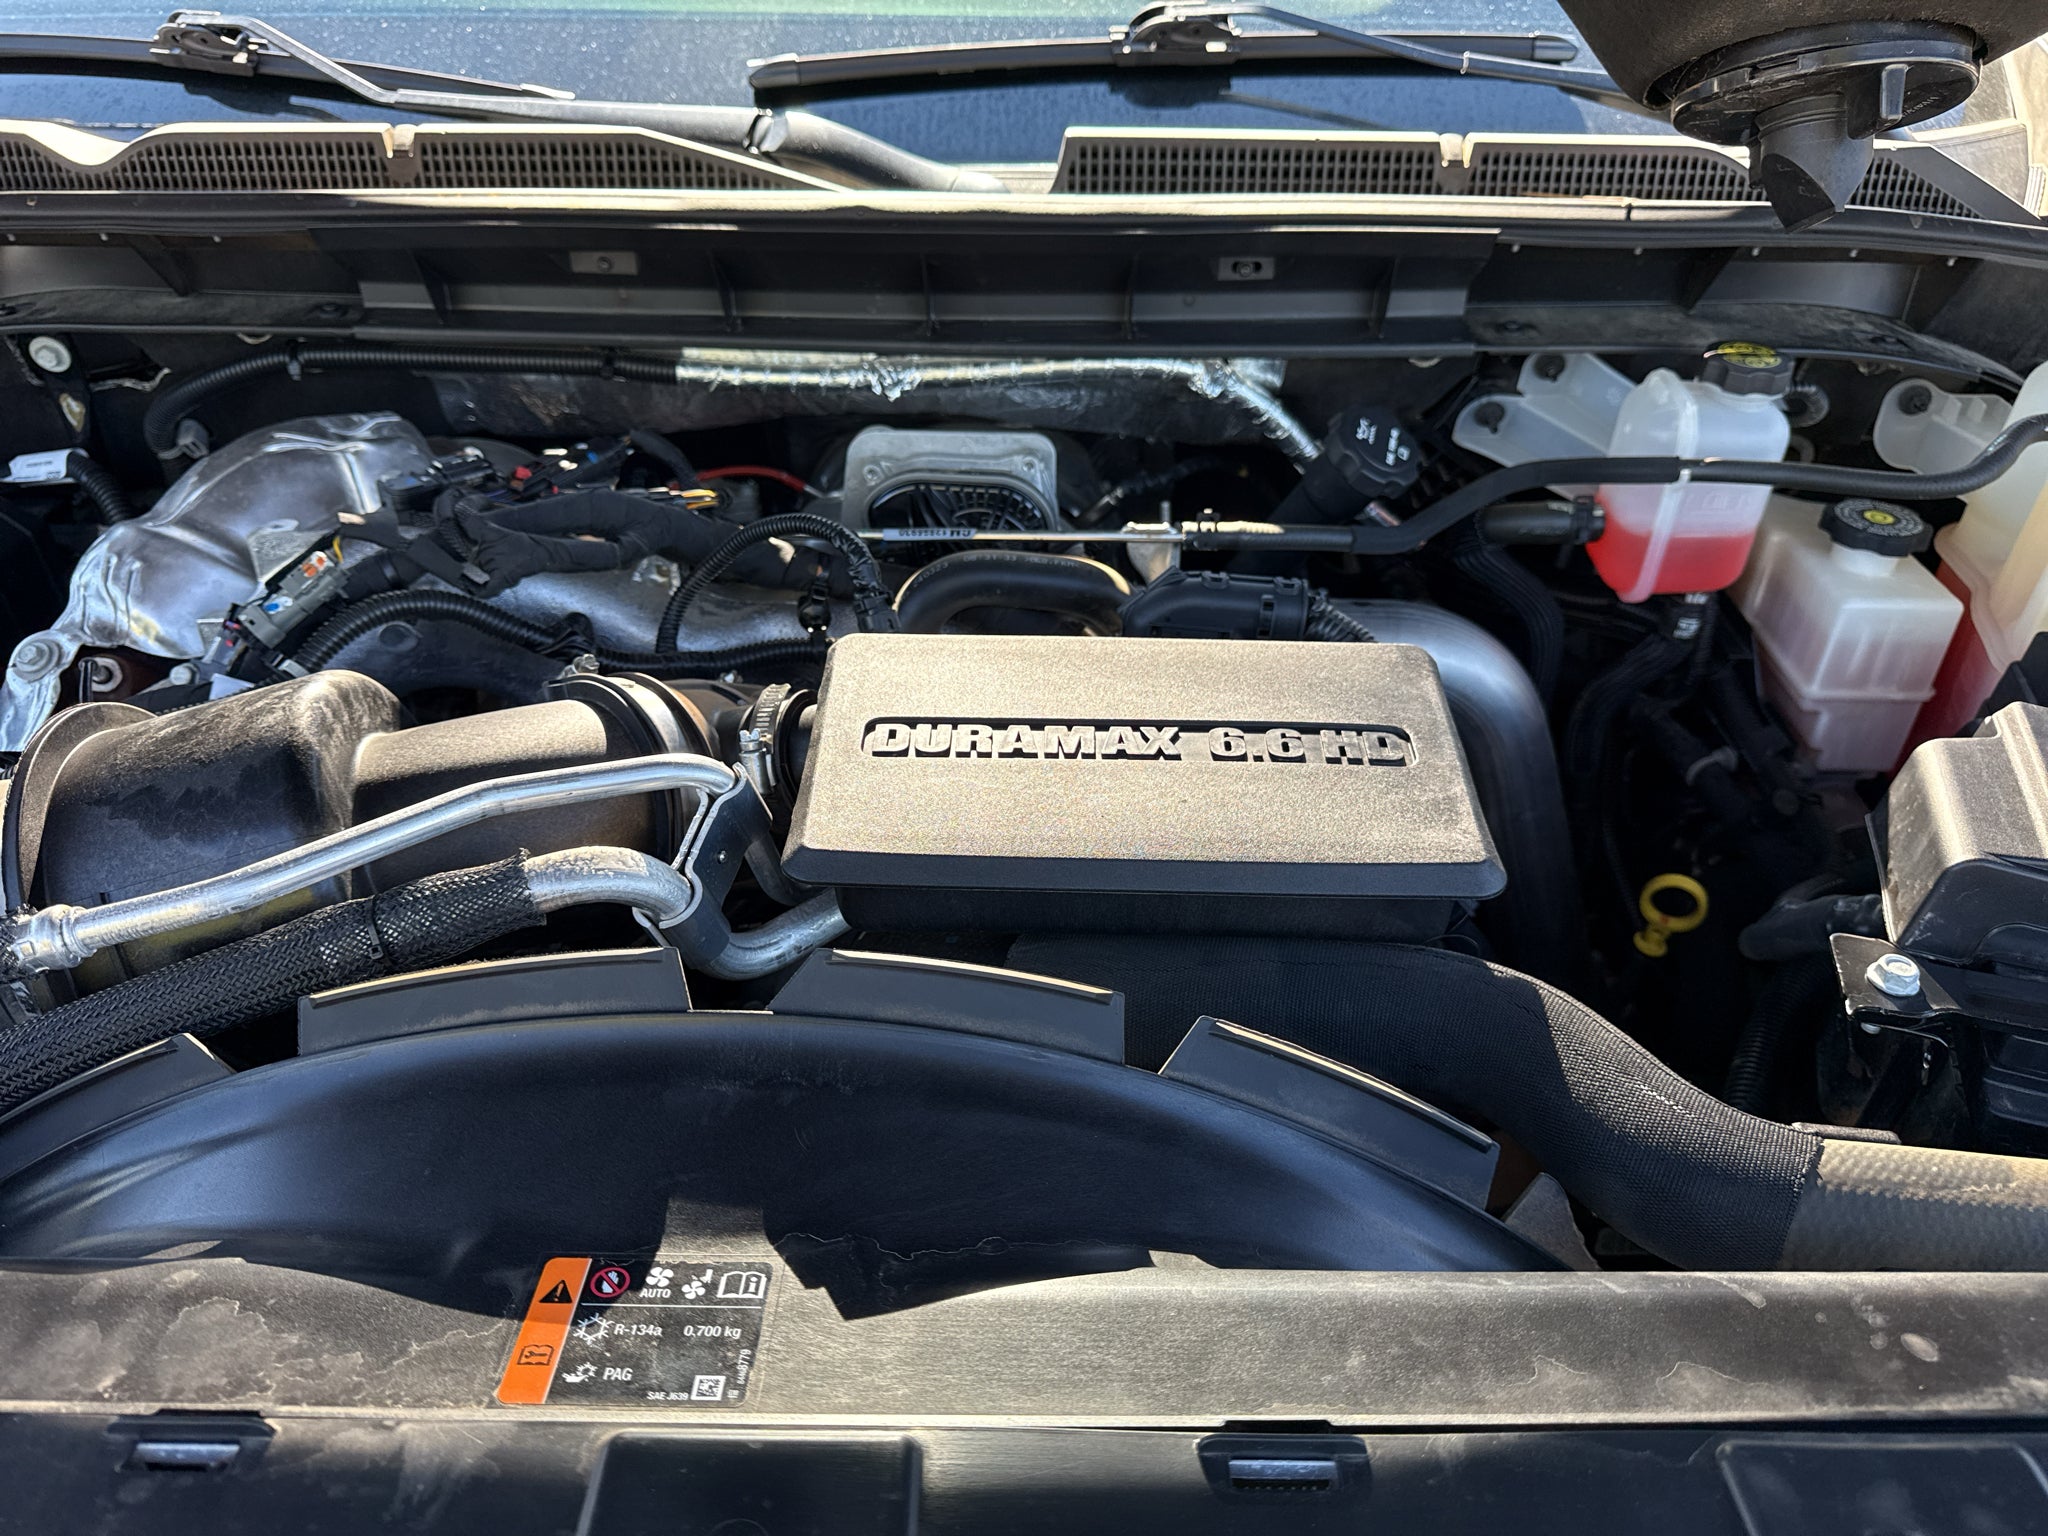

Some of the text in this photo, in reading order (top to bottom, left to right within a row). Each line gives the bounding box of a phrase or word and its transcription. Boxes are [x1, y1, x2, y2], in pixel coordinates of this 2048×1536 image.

[950, 530, 972, 538] GM
[871, 722, 1405, 767] DURAMAX 6.6 HD
[639, 1287, 672, 1299] AUTO
[613, 1323, 663, 1337] R-134a
[724, 1325, 742, 1340] kg
[603, 1367, 633, 1382] PAG
[646, 1391, 689, 1401] SAE J639
